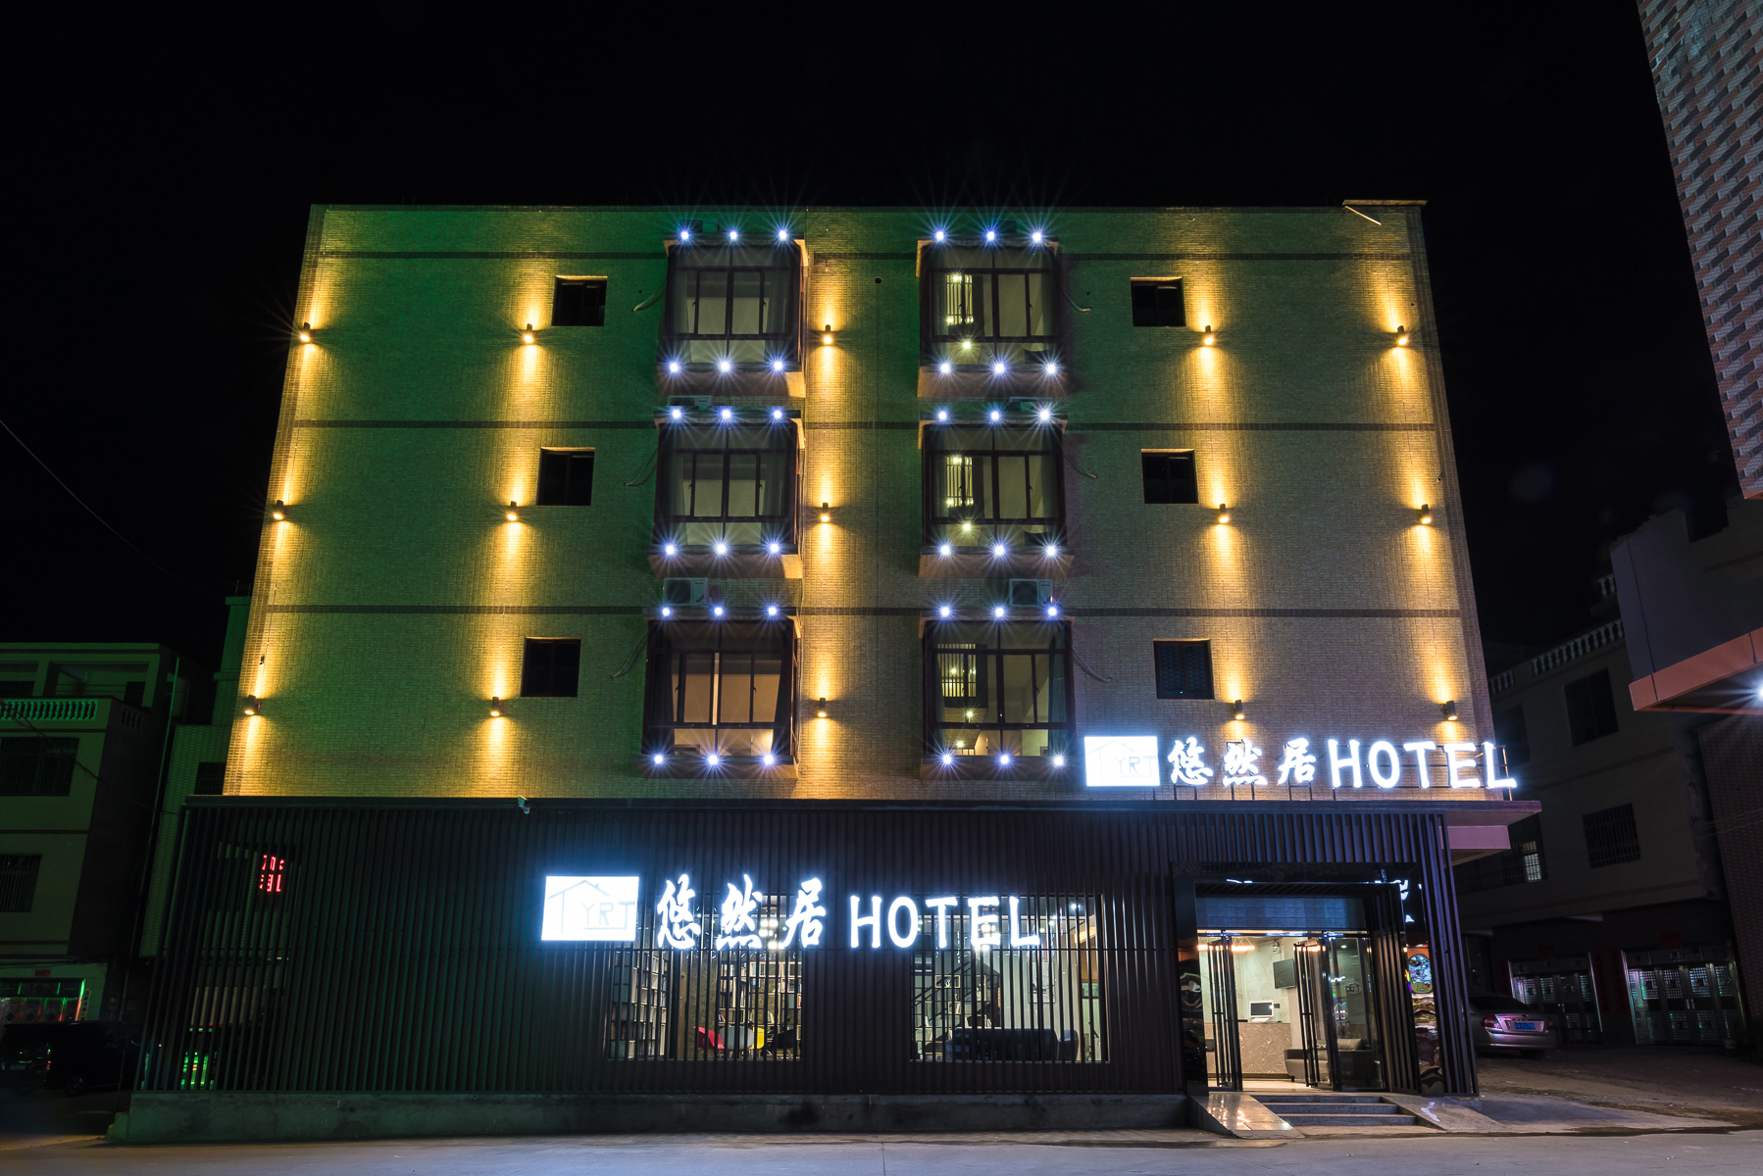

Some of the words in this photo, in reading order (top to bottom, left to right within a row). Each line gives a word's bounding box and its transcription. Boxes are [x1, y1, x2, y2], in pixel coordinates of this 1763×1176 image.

[1168, 736, 1317, 787] 悠然居
[1328, 739, 1517, 789] HOTEL
[581, 901, 636, 929] YRT
[656, 874, 826, 950] 悠然居
[850, 895, 1041, 949] HOTEL
